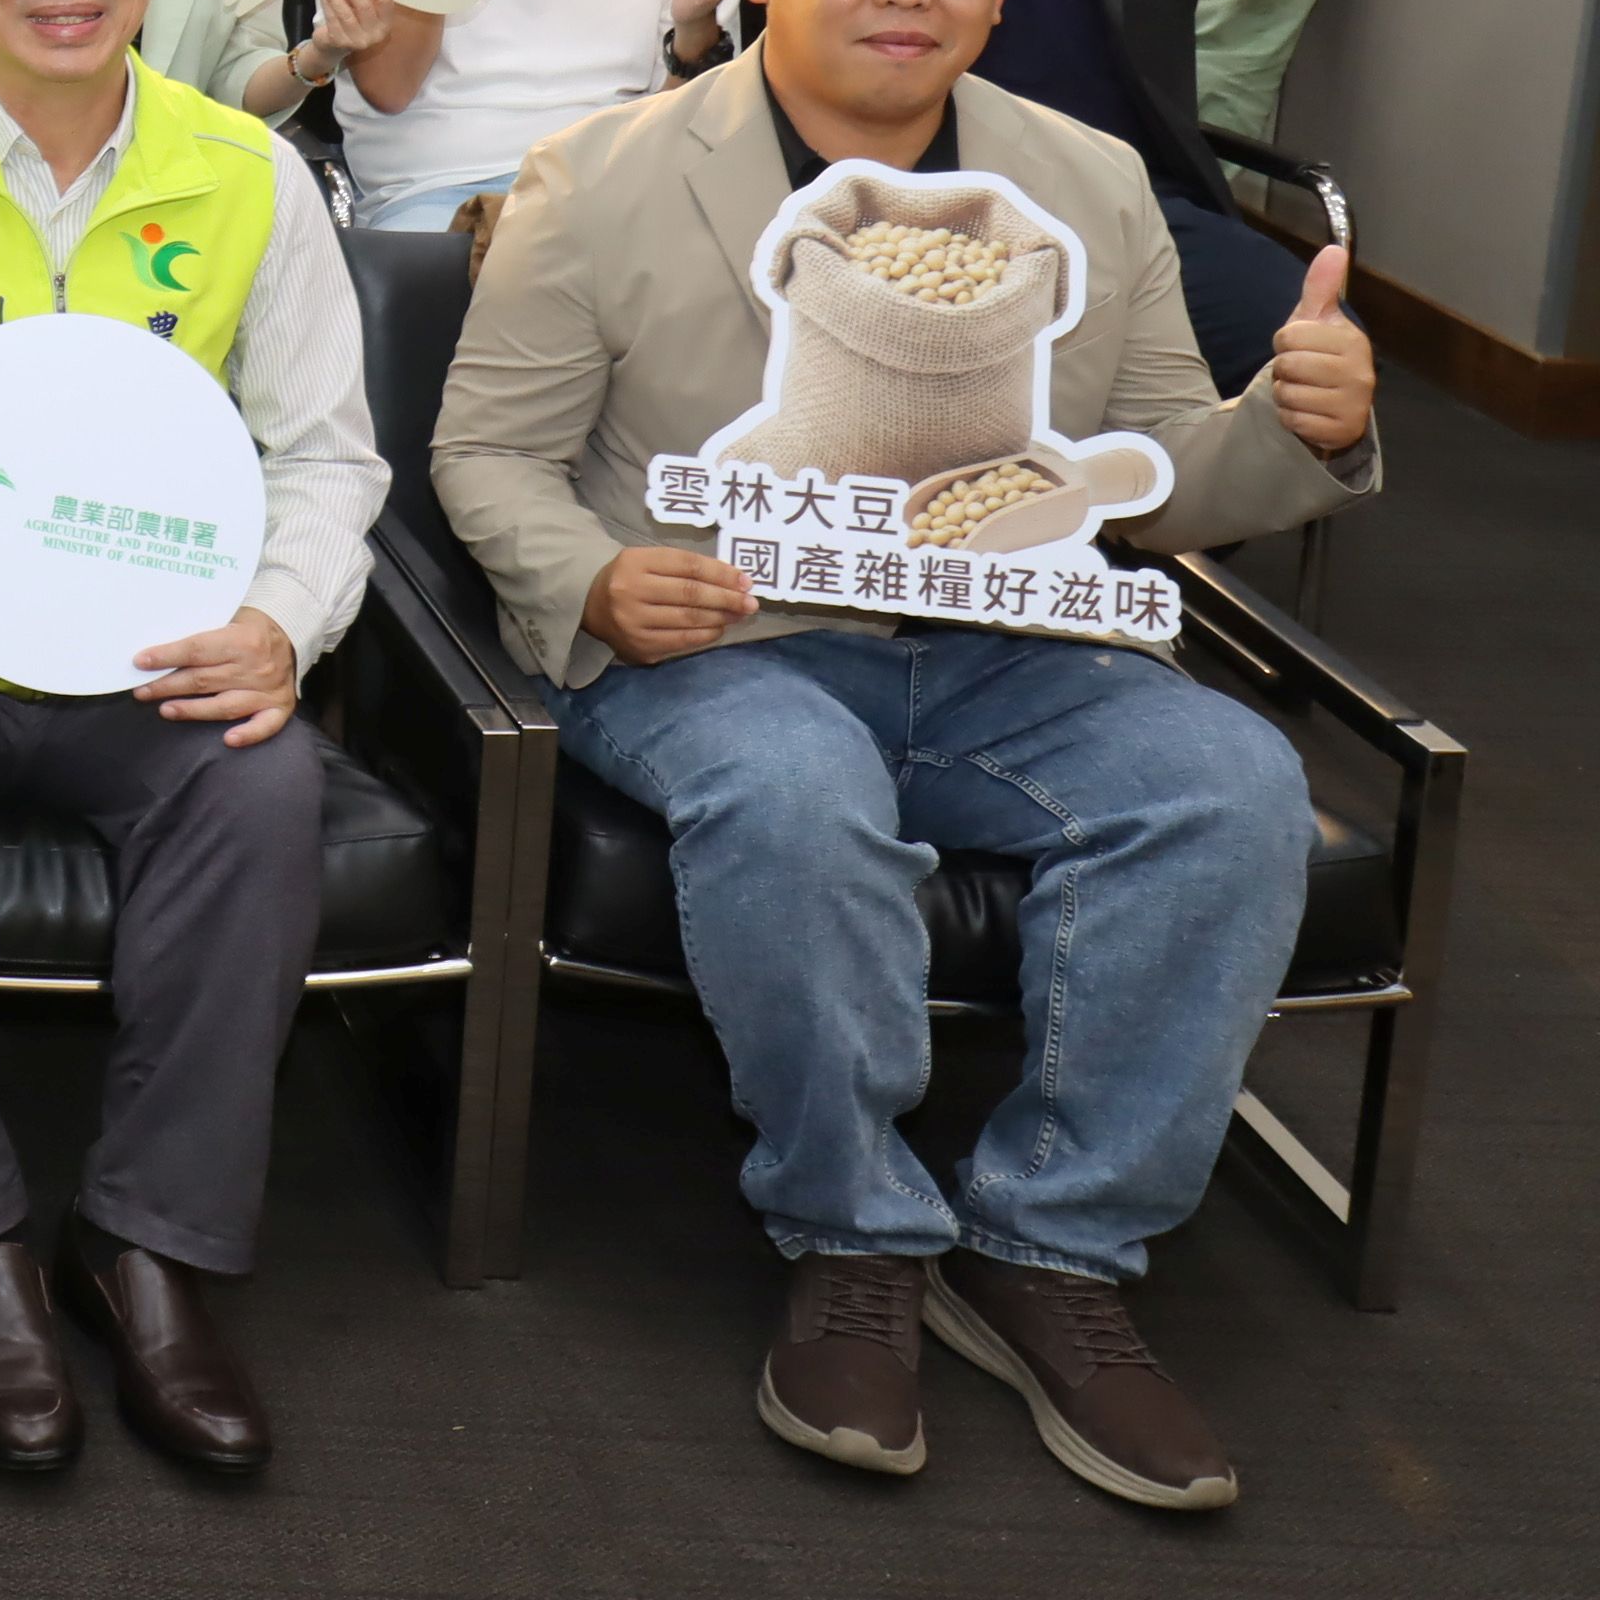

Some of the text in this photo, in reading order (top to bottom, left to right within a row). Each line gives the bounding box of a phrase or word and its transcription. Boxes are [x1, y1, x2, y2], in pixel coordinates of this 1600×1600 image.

[51, 495, 218, 549] 農業部農糧署
[658, 463, 901, 538] 雲林大豆
[23, 518, 239, 570] AGRICULTURE AND FOOD AGENCY,
[42, 537, 216, 580] MINISTRY OF AGRICULTURE
[730, 536, 1174, 632] 國產雜糧好滋味
